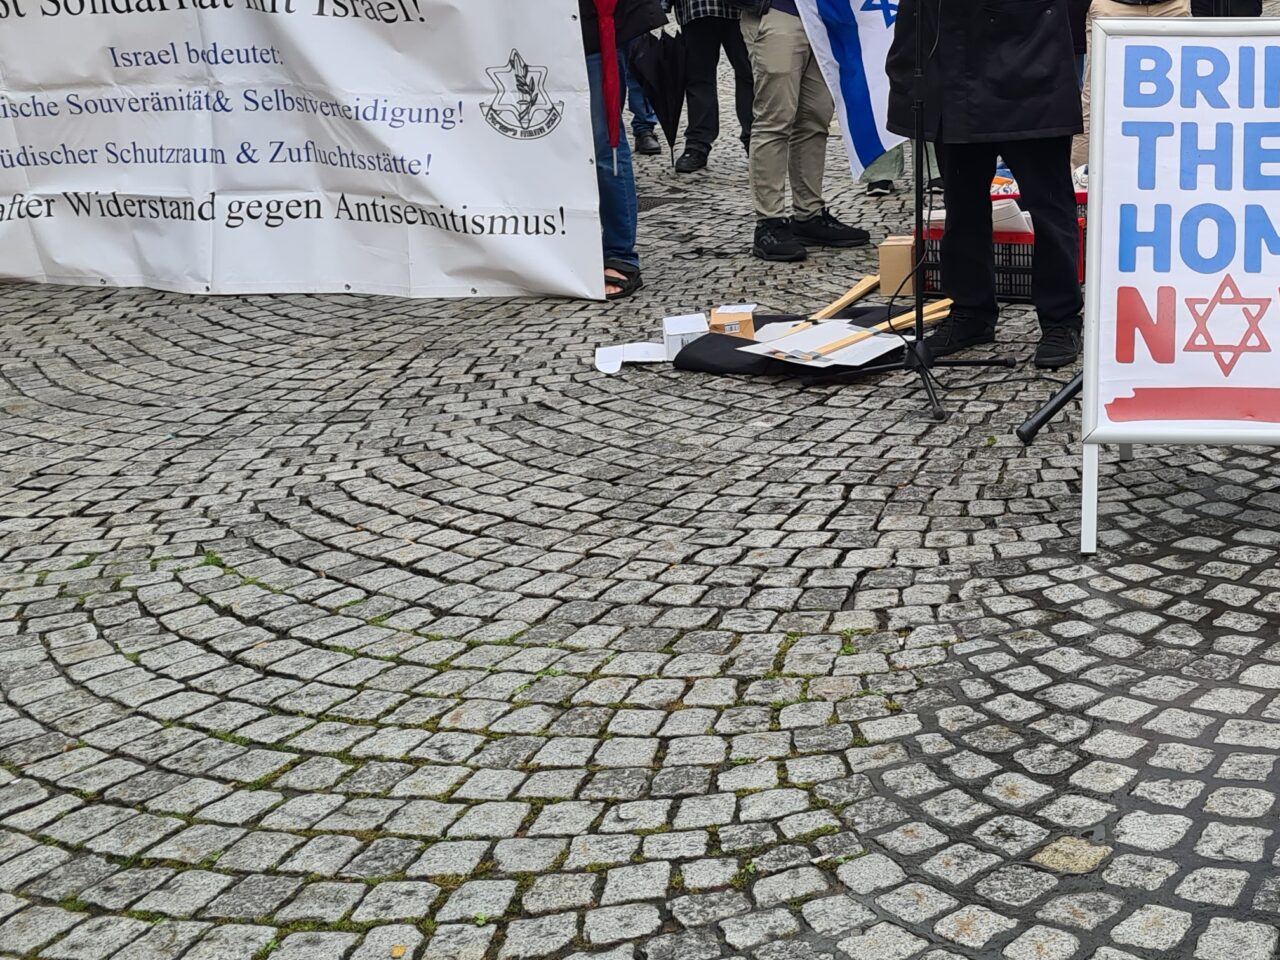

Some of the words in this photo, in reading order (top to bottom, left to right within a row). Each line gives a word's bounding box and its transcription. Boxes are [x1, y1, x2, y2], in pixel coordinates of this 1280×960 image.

[108, 42, 178, 68] Israel
[186, 41, 284, 66] bedeutet:
[244, 89, 464, 129] Selbstverteidigung!
[1, 144, 98, 169] üdischer
[104, 141, 227, 165] Schutzraum
[236, 141, 260, 164] &
[269, 140, 432, 176] Zufluchtsstätte!
[62, 191, 216, 221] Widerstand
[225, 197, 322, 228] gegen
[334, 192, 567, 236] Antisemitismus!
